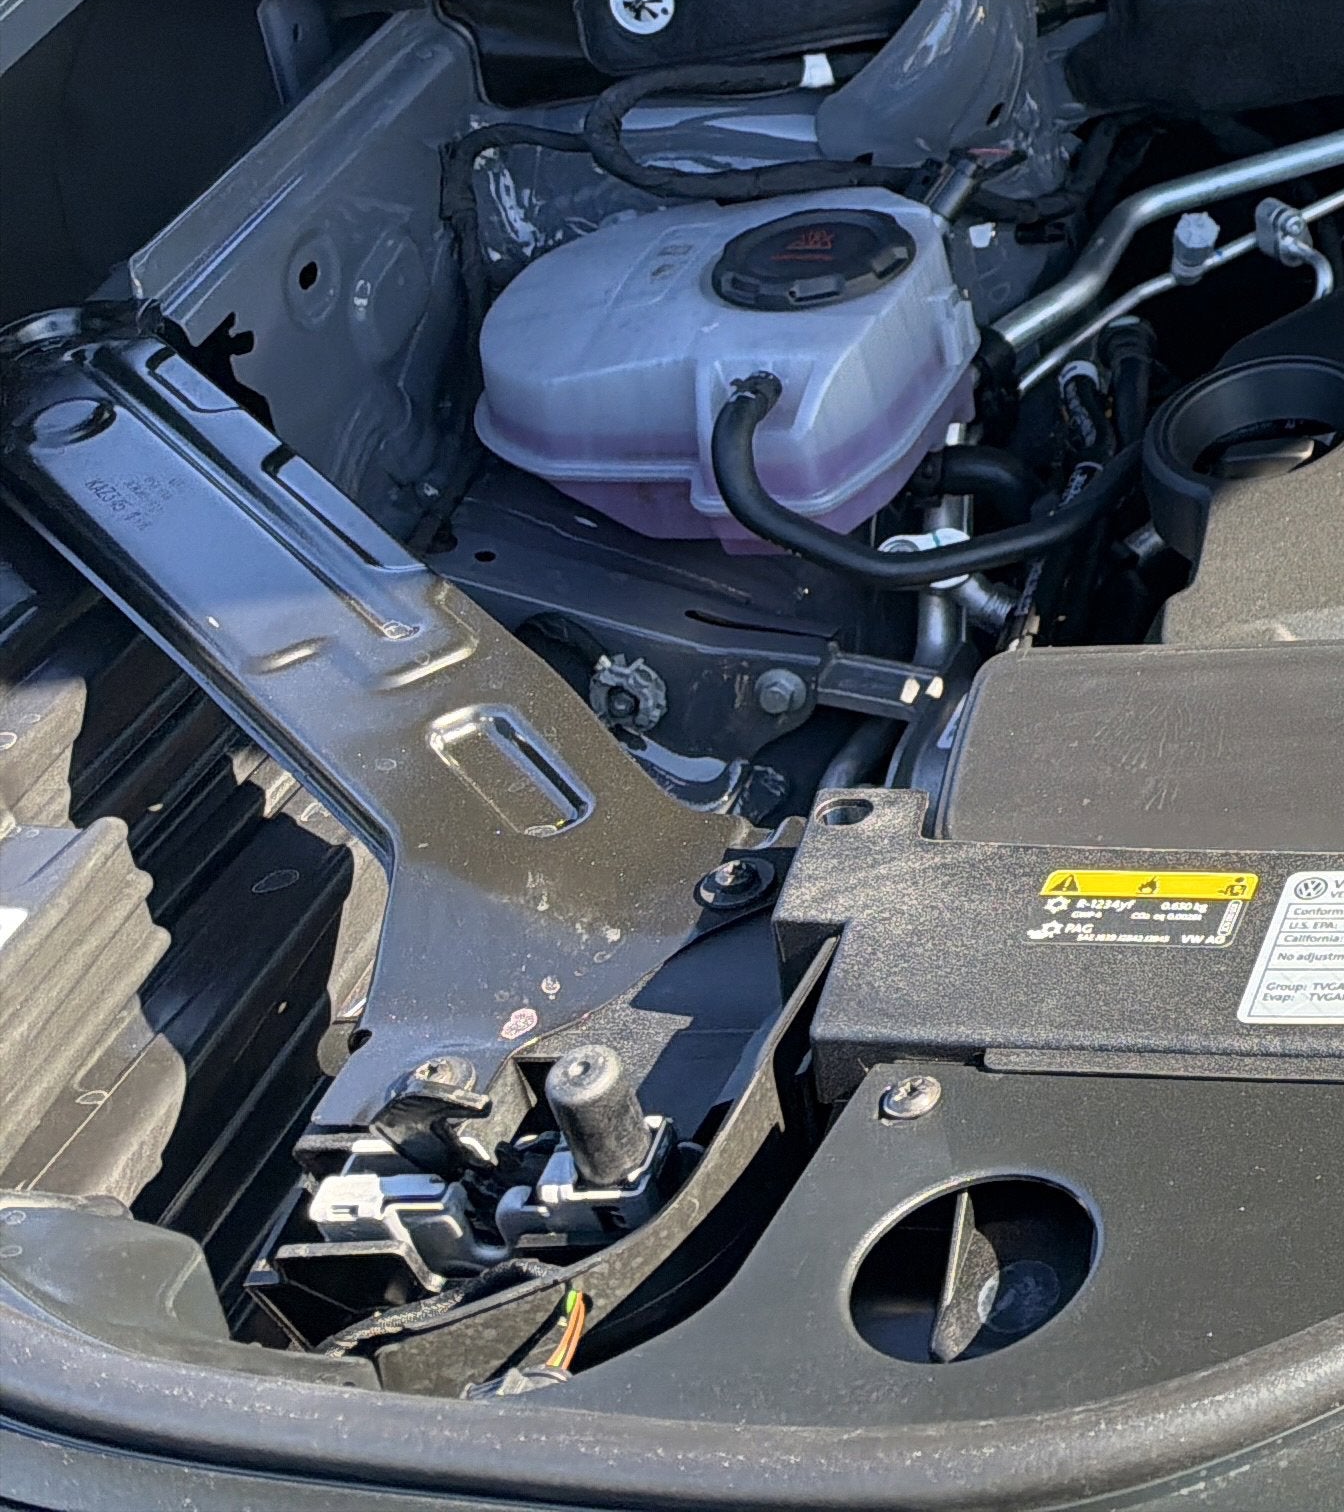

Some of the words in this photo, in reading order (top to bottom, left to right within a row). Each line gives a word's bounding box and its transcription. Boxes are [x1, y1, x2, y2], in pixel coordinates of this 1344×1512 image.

[1193, 901, 1209, 914] kg
[1064, 922, 1095, 934] PAG
[1181, 934, 1205, 944] VW
[1205, 934, 1227, 945] AG
[1283, 934, 1344, 943] California:
[1277, 952, 1295, 961] No
[1266, 982, 1308, 993] Group:
[1262, 993, 1295, 1003] Evap:
